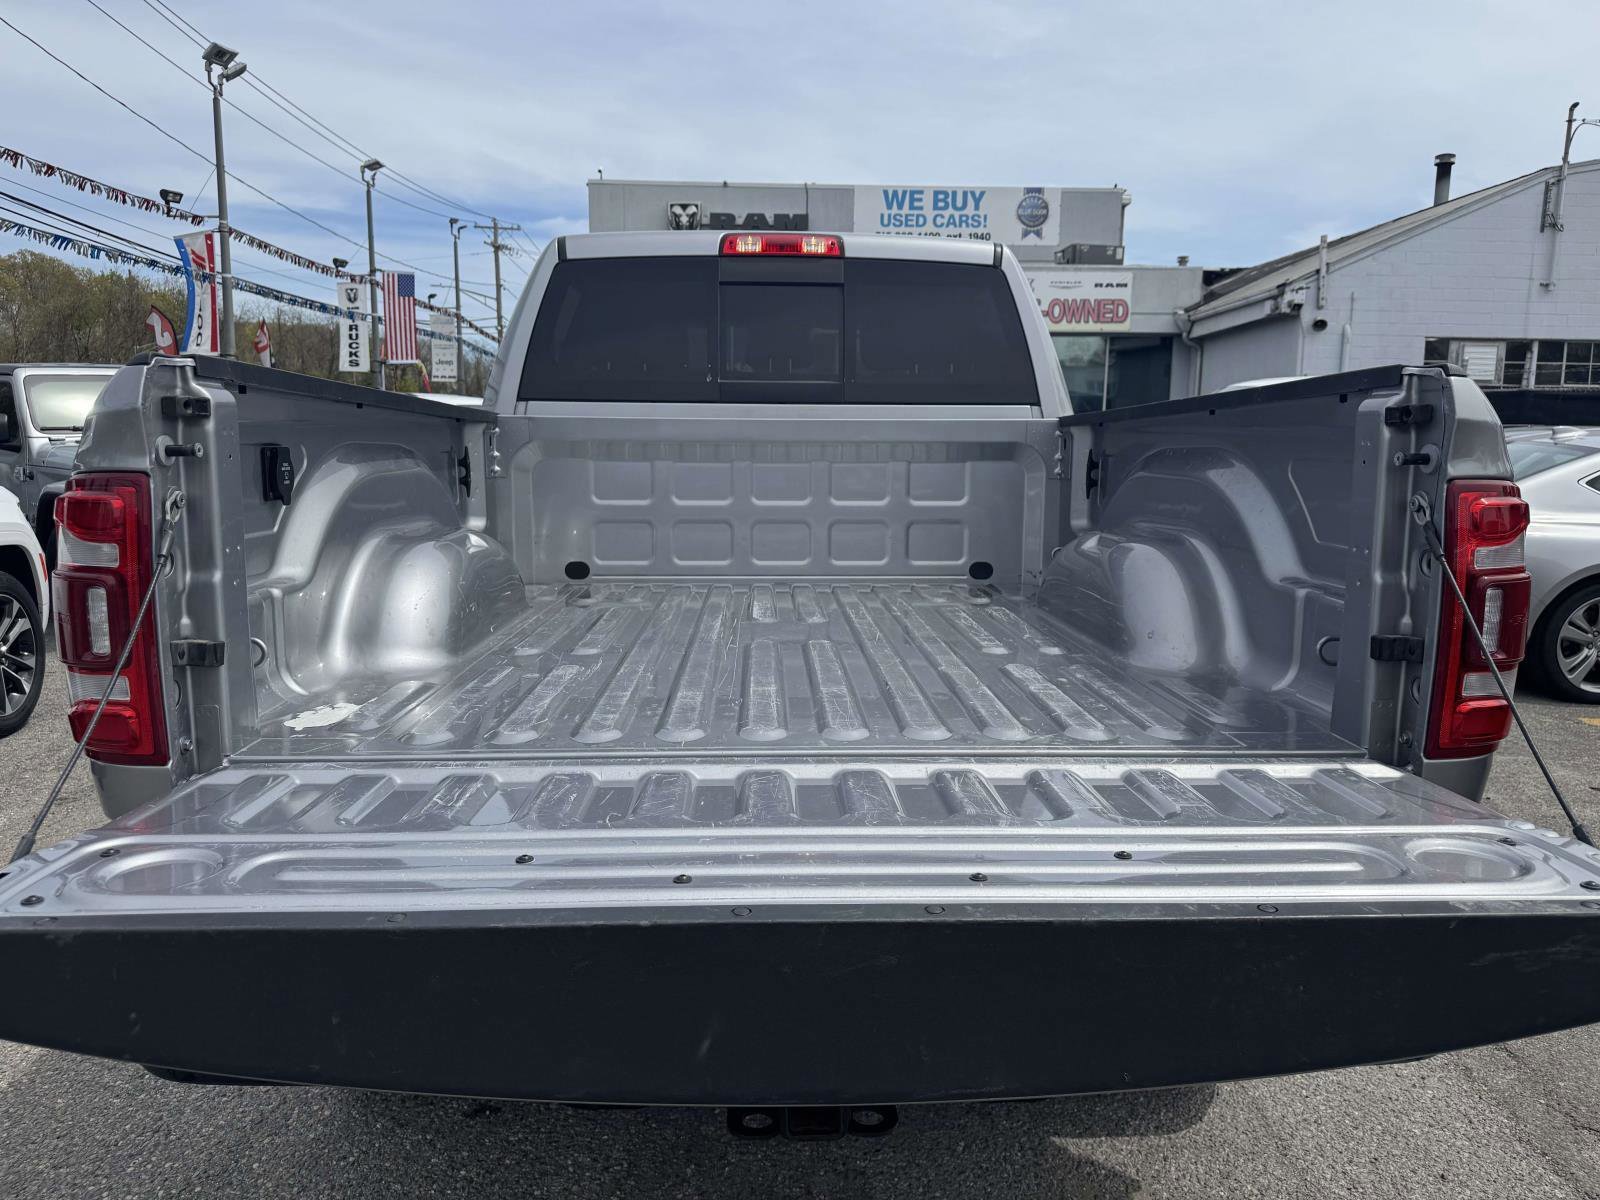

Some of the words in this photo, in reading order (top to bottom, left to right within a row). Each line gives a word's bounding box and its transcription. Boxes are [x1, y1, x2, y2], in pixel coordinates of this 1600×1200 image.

[882, 190, 924, 211] WE
[932, 190, 986, 211] BUY
[709, 213, 809, 231] RAM
[880, 213, 927, 228] USED
[932, 214, 988, 228] CARS!
